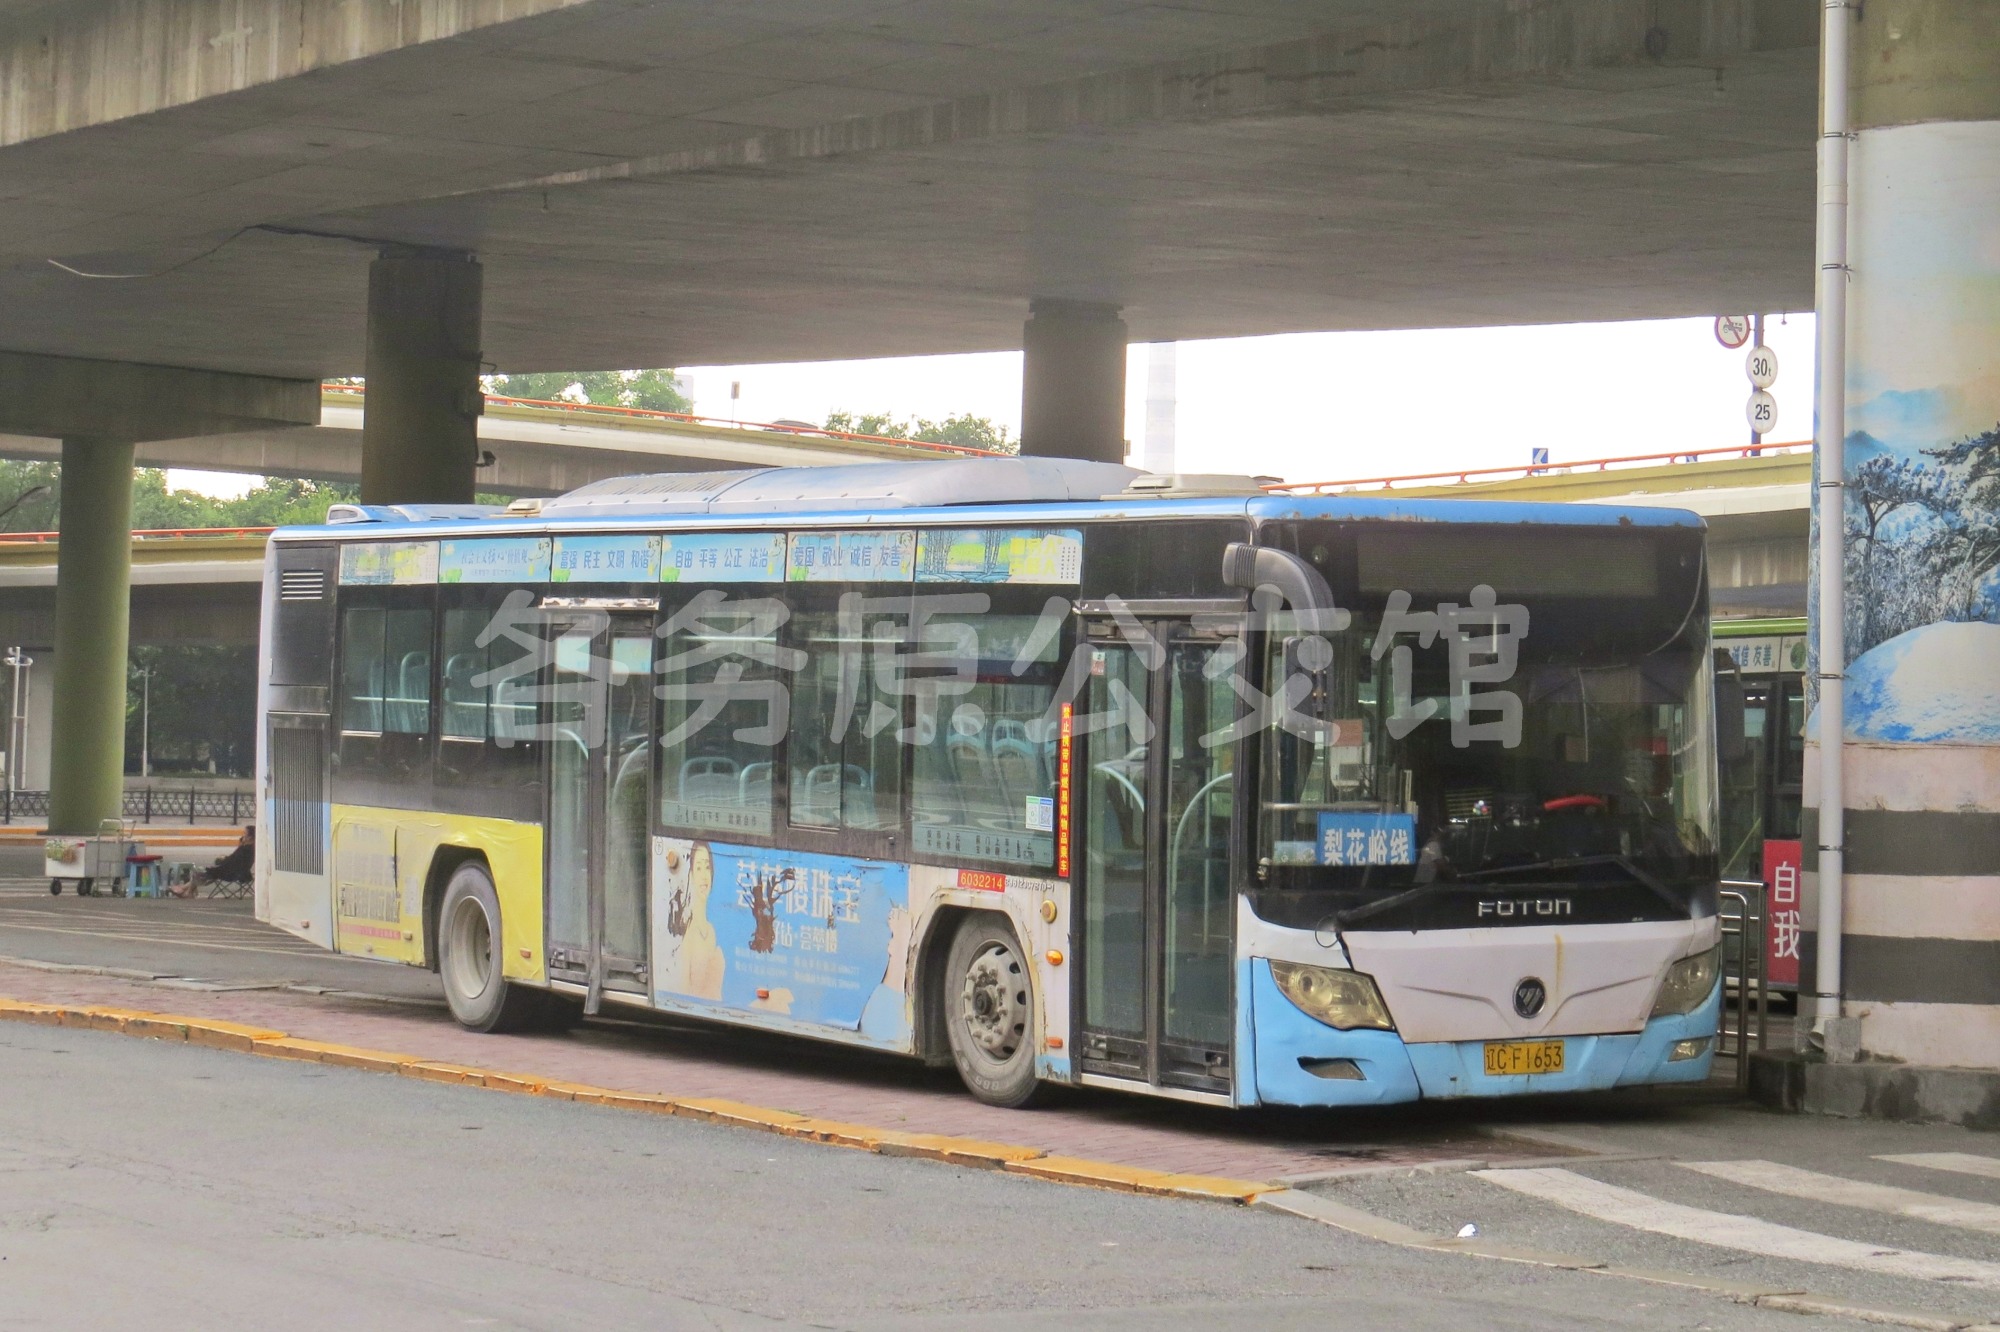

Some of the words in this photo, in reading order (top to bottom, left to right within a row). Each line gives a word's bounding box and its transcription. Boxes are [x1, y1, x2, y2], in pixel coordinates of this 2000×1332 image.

[1755, 404, 1770, 420] 25
[560, 550, 578, 569] 富强
[583, 550, 601, 569] 民主
[607, 550, 625, 569] 文明
[631, 549, 649, 569] 和谐
[675, 549, 693, 568] 自由
[699, 548, 718, 568] 平等
[724, 548, 743, 568] 公正
[749, 548, 768, 568] 法治
[794, 546, 815, 567] 爱国
[821, 545, 843, 567] 敬业
[850, 546, 872, 567] 诚信
[880, 545, 902, 566] 友善
[1753, 644, 1771, 666] 友善
[1324, 828, 1410, 865] 梨花峪线
[960, 872, 1003, 890] 6032214
[1478, 899, 1571, 917] FOTON
[1774, 861, 1800, 960] 自我
